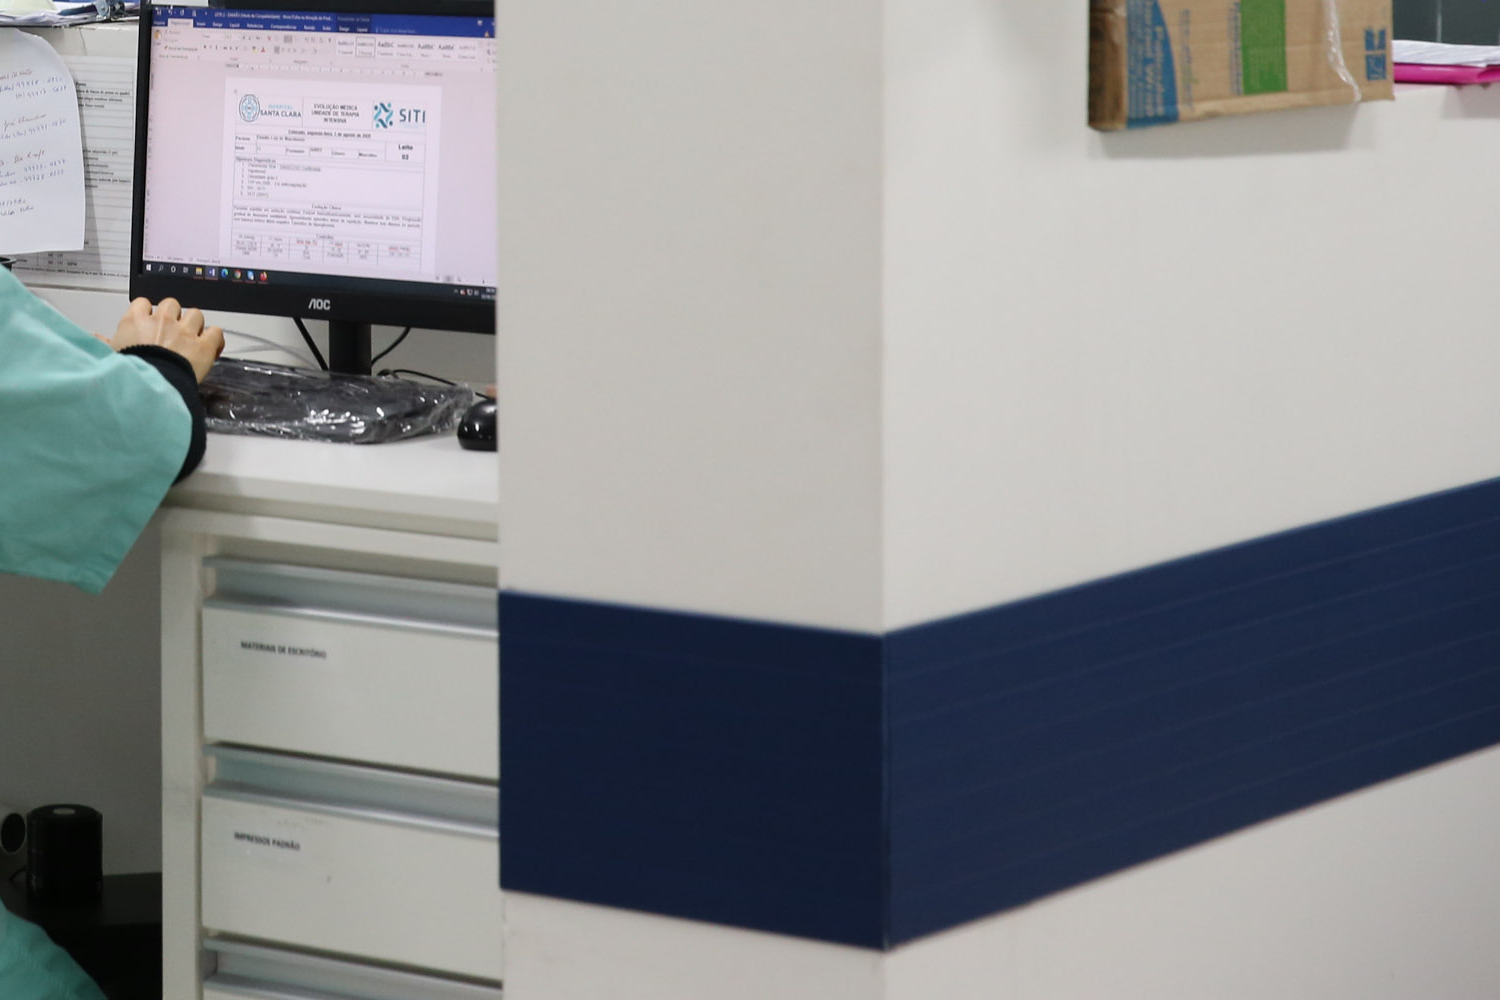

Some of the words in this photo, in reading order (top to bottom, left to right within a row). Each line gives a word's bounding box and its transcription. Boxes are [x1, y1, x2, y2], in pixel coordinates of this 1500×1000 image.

[313, 103, 339, 111] EVOLUÇÃO
[260, 109, 280, 117] SANTA
[280, 110, 302, 118] CLARA
[399, 108, 427, 123] SITI
[308, 298, 331, 310] AOC
[240, 641, 276, 653] MATERIAIS
[277, 645, 286, 654] DE
[287, 646, 327, 659] ESCRITÓRIO
[271, 838, 301, 851] PADRÃO
